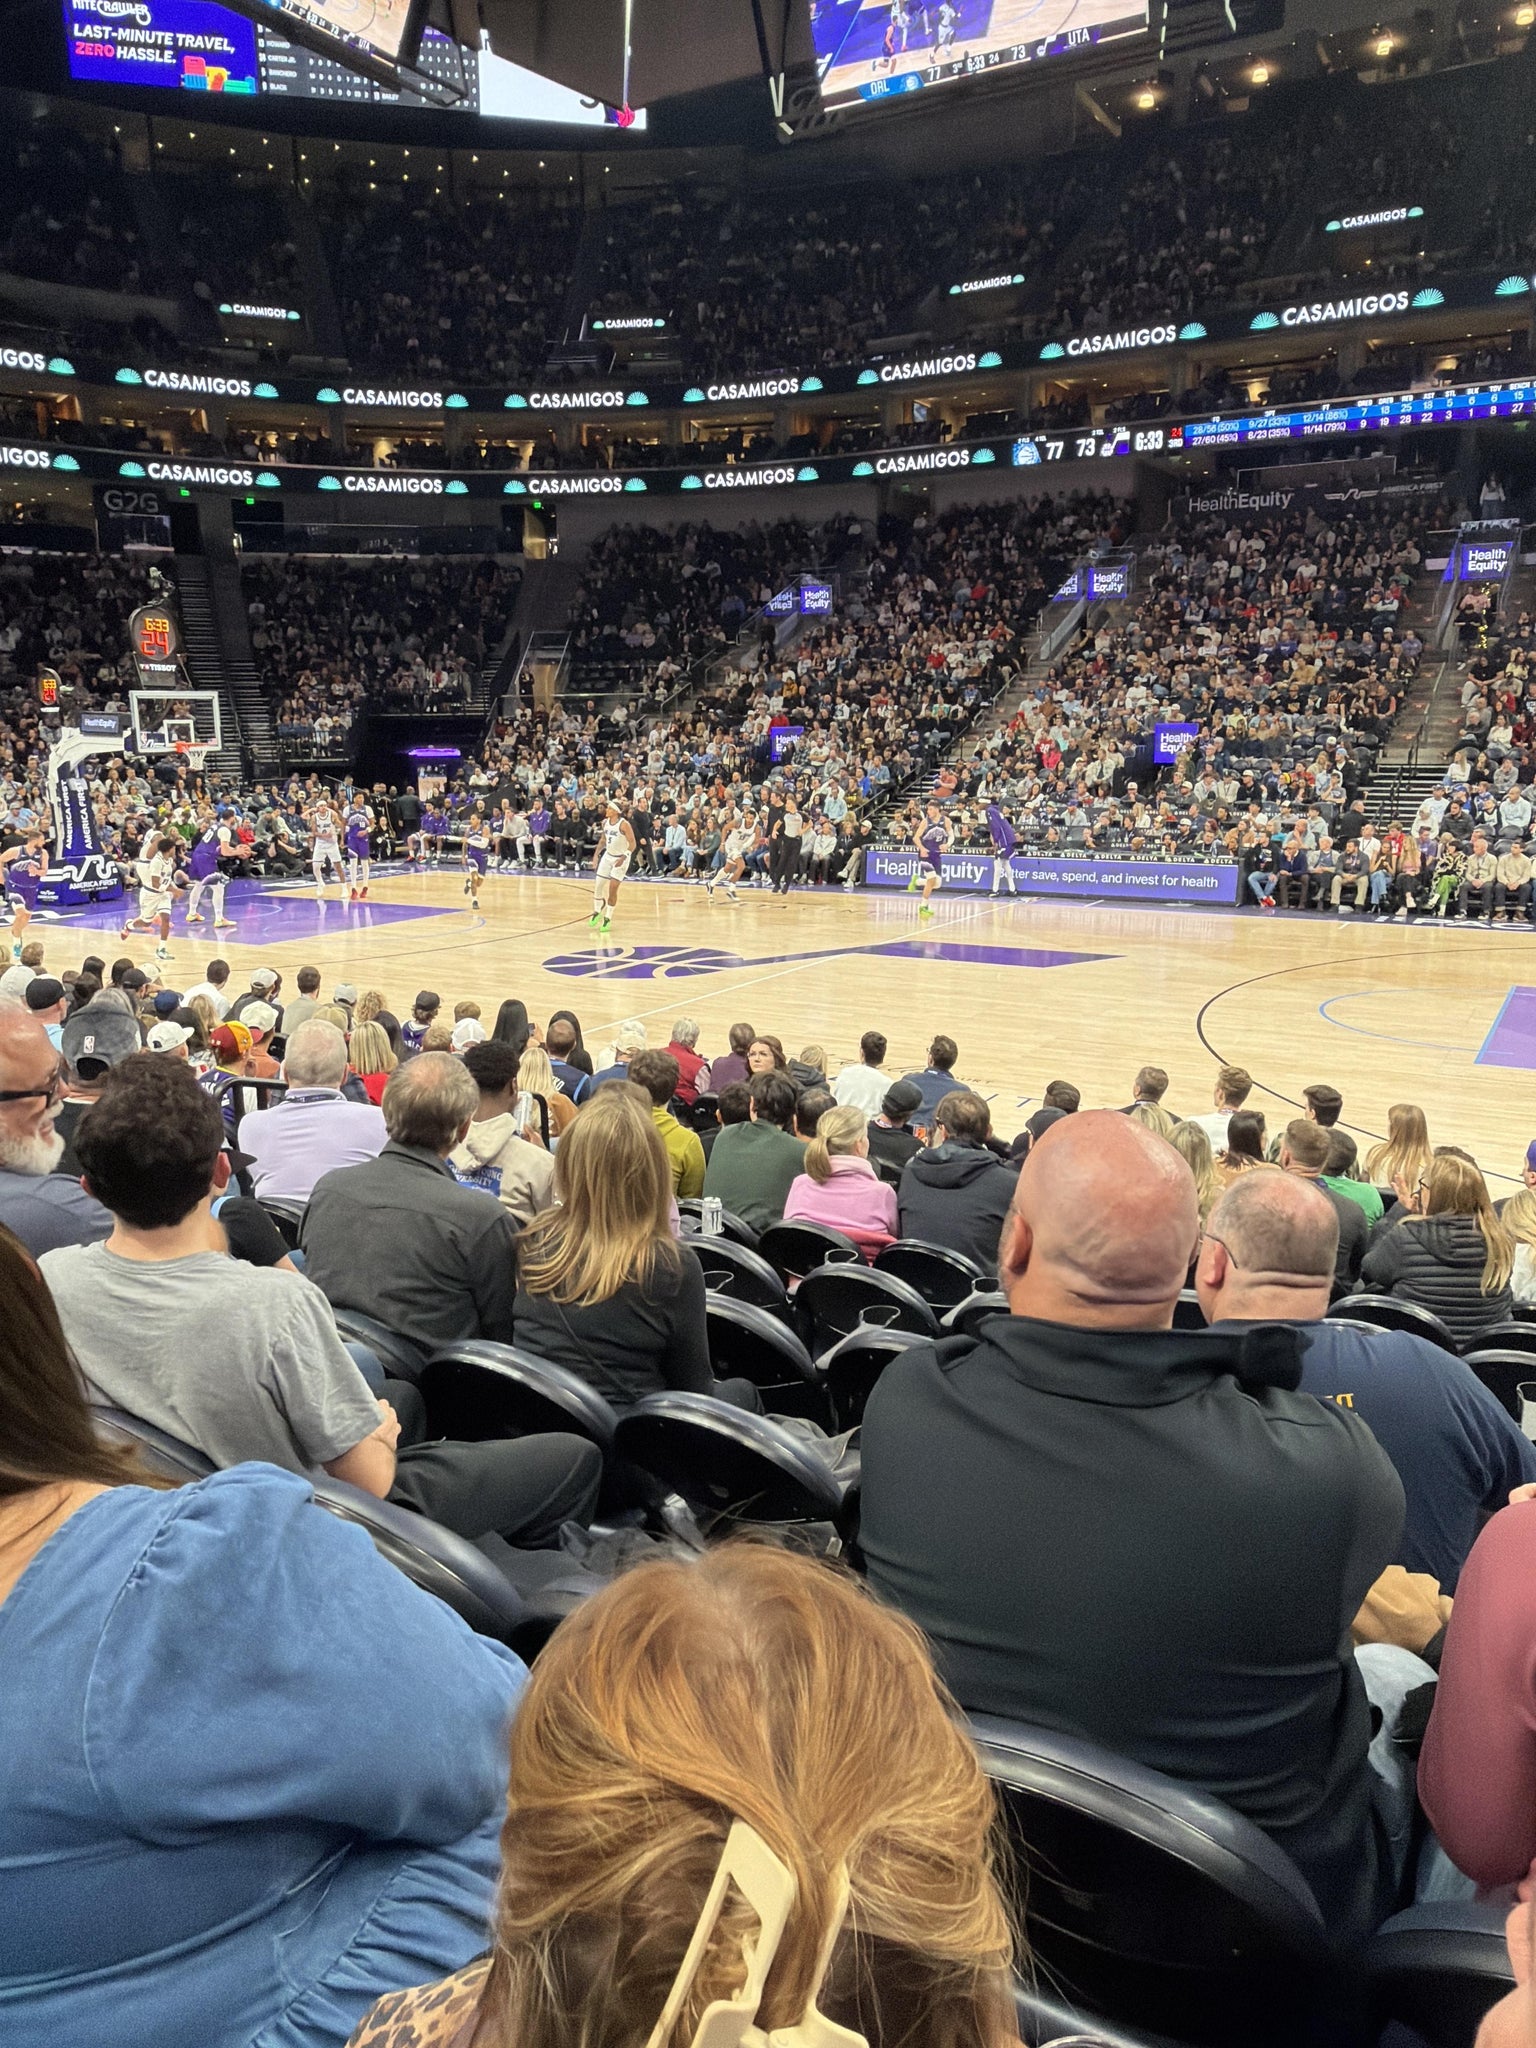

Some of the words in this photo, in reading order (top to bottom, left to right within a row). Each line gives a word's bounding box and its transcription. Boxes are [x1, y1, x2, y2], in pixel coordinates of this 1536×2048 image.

[74, 24, 174, 46] LAST-MINUTE
[176, 34, 235, 54] TRAVEL,
[75, 41, 114, 57] ZERO
[116, 46, 177, 64] HASSLE.
[870, 81, 890, 94] ORL
[928, 68, 941, 81] 77
[967, 56, 985, 71] 6:33
[989, 54, 1000, 64] 24
[1011, 46, 1026, 60] 73
[1068, 30, 1090, 46] UTA
[1342, 208, 1407, 228] CASAMIGOS
[962, 276, 1012, 292] CASAMIGOS
[233, 304, 286, 318] CASAMIGOS
[1283, 292, 1408, 326] CASAMIGOS
[605, 318, 654, 329] CASAMIGOS
[1067, 325, 1176, 356] CASAMIGOS
[881, 354, 976, 382] CASAMIGOS
[144, 370, 251, 396] CASAMIGOS
[707, 378, 798, 401] CASAMIGOS
[343, 388, 443, 408] CASAMIGOS
[530, 392, 624, 408] CASAMIGOS
[1193, 425, 1217, 434] 28/56
[1217, 422, 1239, 432] (50%)
[1248, 419, 1267, 428] 9/27
[1268, 416, 1290, 426] (33%)
[1303, 412, 1324, 422] 12/14
[1362, 408, 1368, 416] 7
[1381, 406, 1390, 414] 18
[1401, 403, 1412, 412] 25
[1424, 401, 1433, 409] 18
[1446, 399, 1453, 407] 5
[1469, 396, 1475, 405] 6
[1491, 394, 1498, 402] 6
[1514, 391, 1524, 400] 15
[1171, 427, 1182, 438] 24
[1192, 435, 1216, 445] 27/60
[1217, 433, 1238, 443] (45%)
[1248, 430, 1267, 440] 8/23
[1268, 428, 1290, 438] (35%)
[1304, 425, 1322, 434] 11/14
[1324, 422, 1346, 432] (79%)
[1361, 420, 1366, 428] 9
[1380, 417, 1389, 426] 19
[1400, 415, 1412, 424] 28
[1422, 413, 1433, 421] 22
[1445, 410, 1452, 419] 3
[1469, 408, 1473, 417] 1
[1490, 406, 1497, 414] 8
[1512, 403, 1524, 412] 27
[1046, 441, 1064, 460] 77
[1076, 438, 1096, 457] 73
[1135, 430, 1163, 451] 6:33
[1168, 438, 1184, 448] 3RD
[0, 446, 50, 468] IGOS
[876, 450, 970, 474] CASAMIGOS
[148, 462, 252, 486] CASAMIGOS
[704, 468, 795, 488] CASAMIGOS
[344, 476, 443, 495] CASAMIGOS
[528, 478, 622, 494] CASAMIGOS
[1189, 491, 1292, 512] HealthEquity
[1468, 549, 1506, 561] Health
[1468, 559, 1507, 573] Equity
[1094, 573, 1123, 582] Health
[1094, 582, 1124, 593] Equity
[804, 590, 829, 600] Health
[805, 599, 830, 609] Equity
[145, 618, 169, 632] 6:33
[141, 630, 169, 655] 24
[1161, 733, 1193, 742] Health
[61, 780, 70, 807] FIRST
[80, 808, 93, 849] AMERICA
[876, 858, 984, 883] Healtquity
[1032, 870, 1059, 881] save,
[1062, 871, 1098, 884] spend,
[1101, 872, 1122, 884] and
[1126, 874, 1158, 885] invest
[1162, 875, 1178, 886] for
[1181, 876, 1218, 888] health
[69, 880, 98, 890] AMERICA
[99, 878, 118, 887] FIRST
